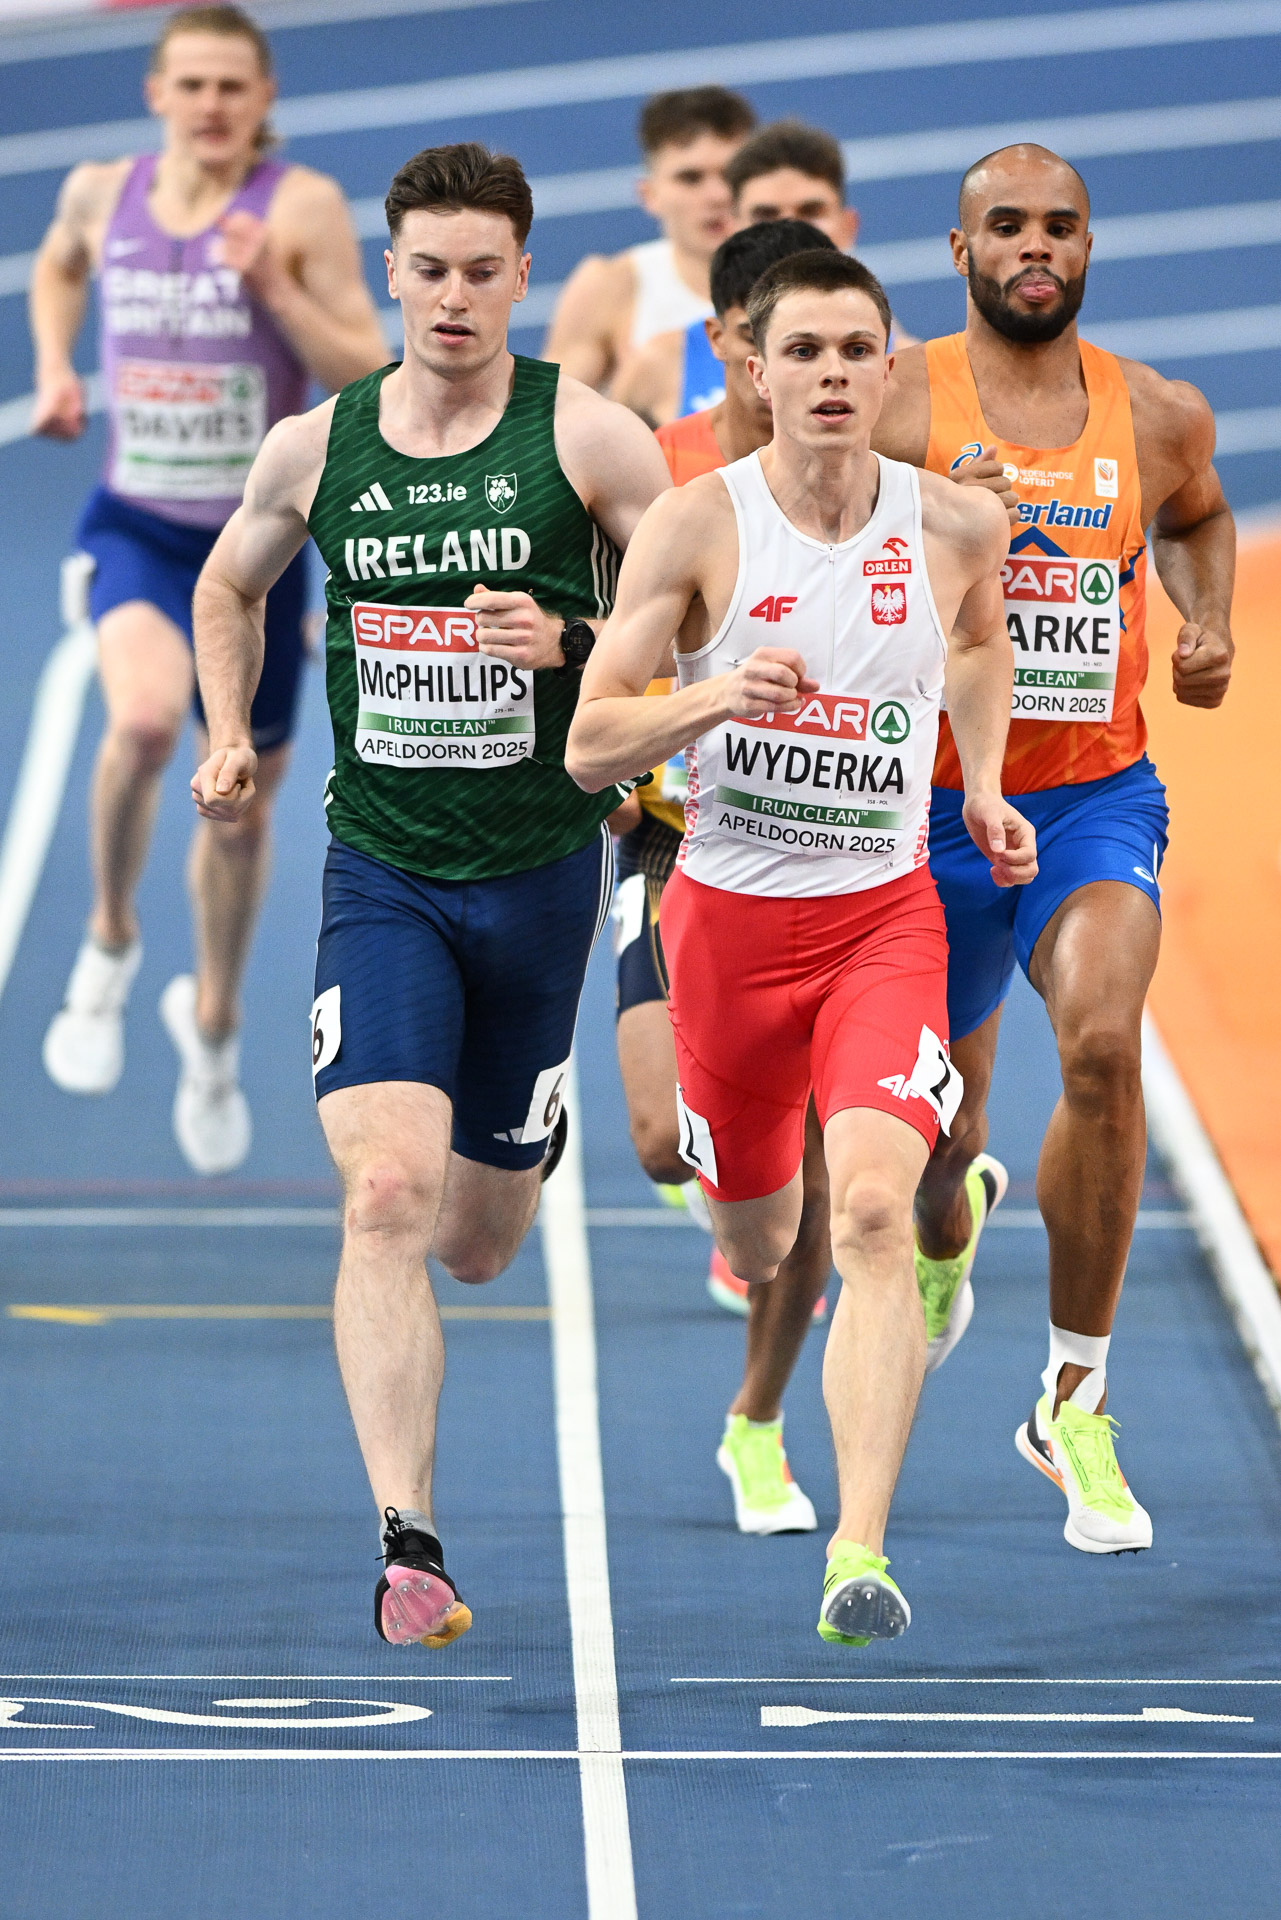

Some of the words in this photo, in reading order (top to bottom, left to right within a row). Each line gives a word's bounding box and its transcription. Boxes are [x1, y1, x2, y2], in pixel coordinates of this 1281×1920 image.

[1019, 468, 1074, 480] NEDERLANDSE
[1019, 476, 1055, 487] LOTERIJ
[407, 483, 467, 505] 123.ie
[344, 527, 532, 581] IRELAND
[865, 560, 909, 574] ORLEN
[748, 595, 798, 623] 4F
[358, 612, 477, 646] SPAR
[360, 658, 528, 703] McPHILLIPS
[1069, 697, 1107, 713] 2025
[394, 719, 427, 734] RUN
[361, 738, 476, 760] APELDOORN
[482, 741, 528, 759] 2025
[724, 732, 904, 795] WYDERKA
[752, 797, 758, 811] I
[760, 798, 800, 818] RUN
[718, 812, 845, 850] APELDOORN
[849, 835, 896, 853] 2025
[313, 1008, 324, 1066] 6
[543, 1072, 564, 1129] 6
